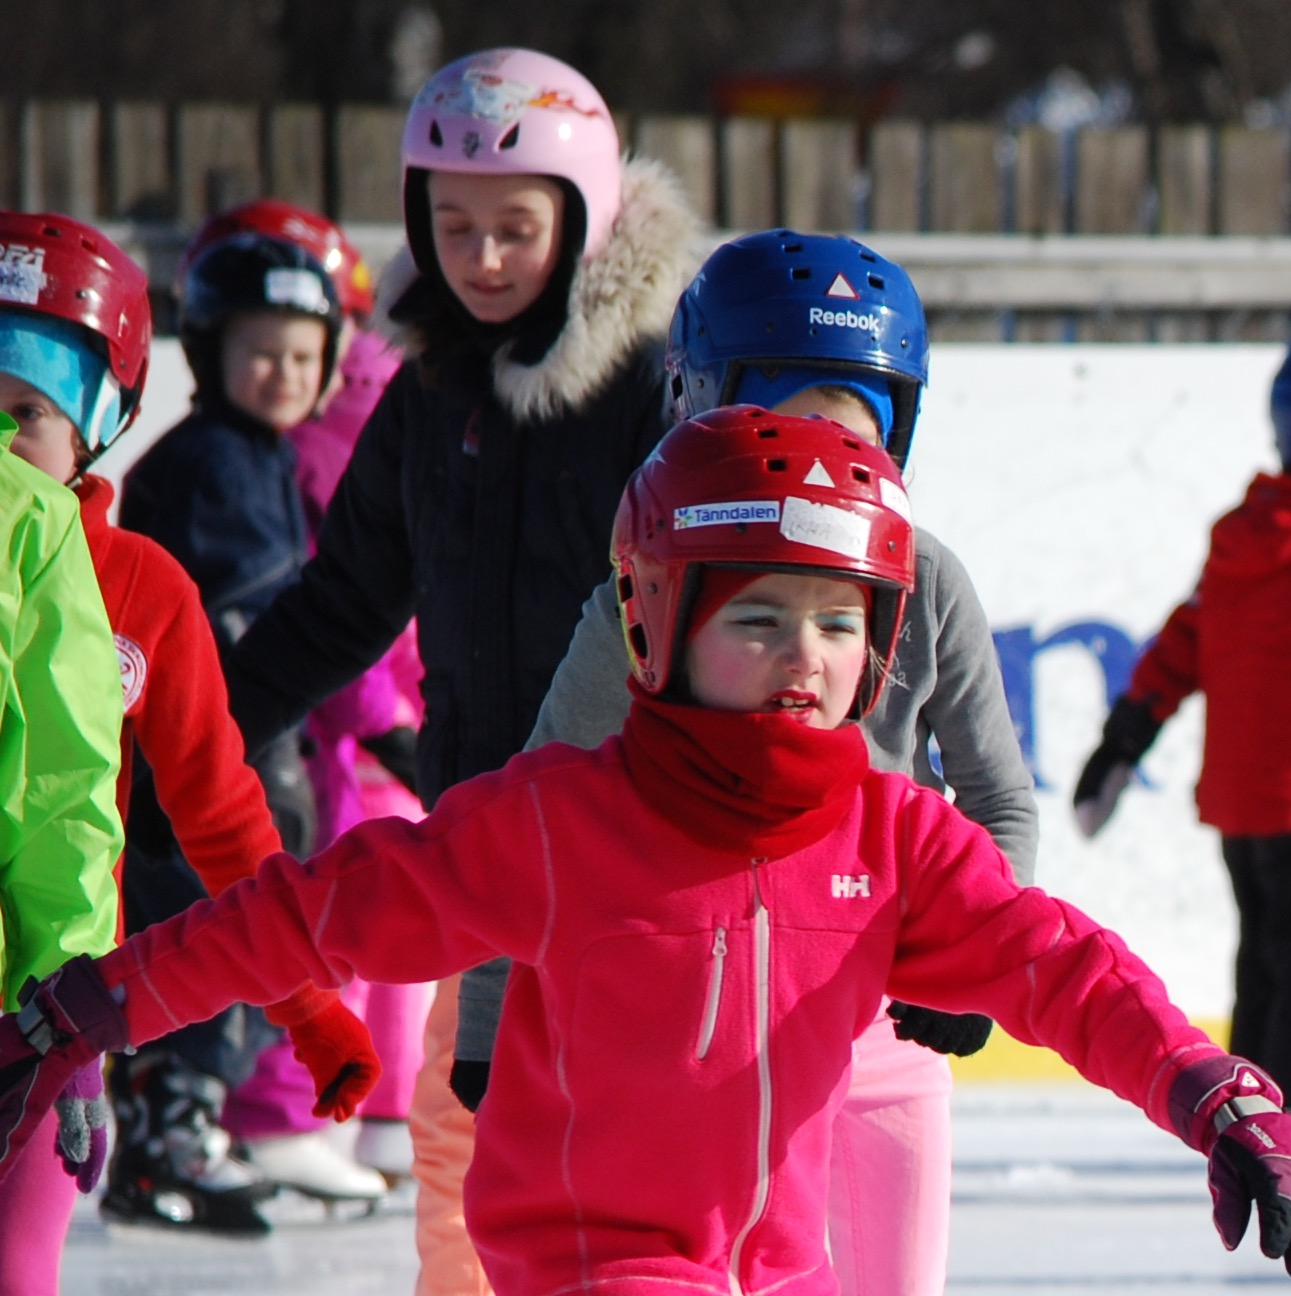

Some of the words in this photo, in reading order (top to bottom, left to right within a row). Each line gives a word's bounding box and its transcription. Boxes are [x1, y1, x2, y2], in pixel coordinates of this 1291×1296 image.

[809, 307, 881, 333] Reebok
[693, 506, 777, 523] Tänndalen
[831, 874, 871, 898] HH
